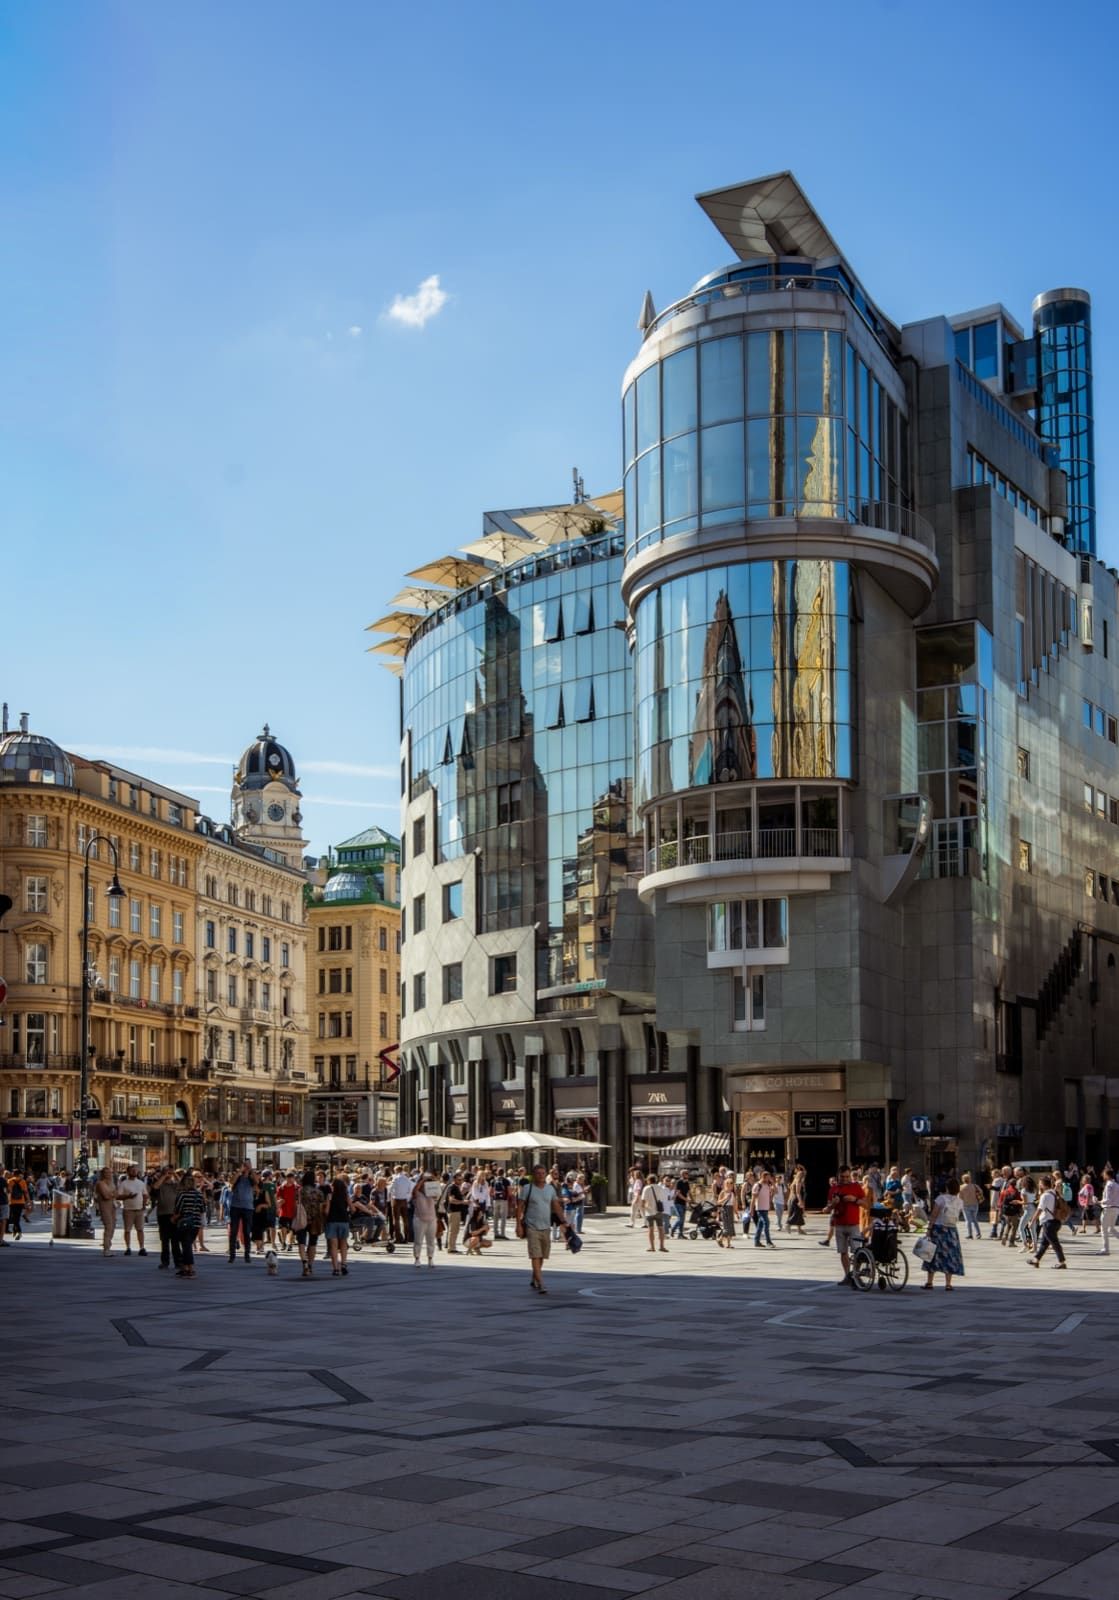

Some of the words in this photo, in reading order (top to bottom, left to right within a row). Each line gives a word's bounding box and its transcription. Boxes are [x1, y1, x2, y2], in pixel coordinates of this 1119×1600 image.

[785, 1076, 824, 1087] HOTEL
[648, 1092, 668, 1103] ZARA
[912, 1119, 925, 1133] U
